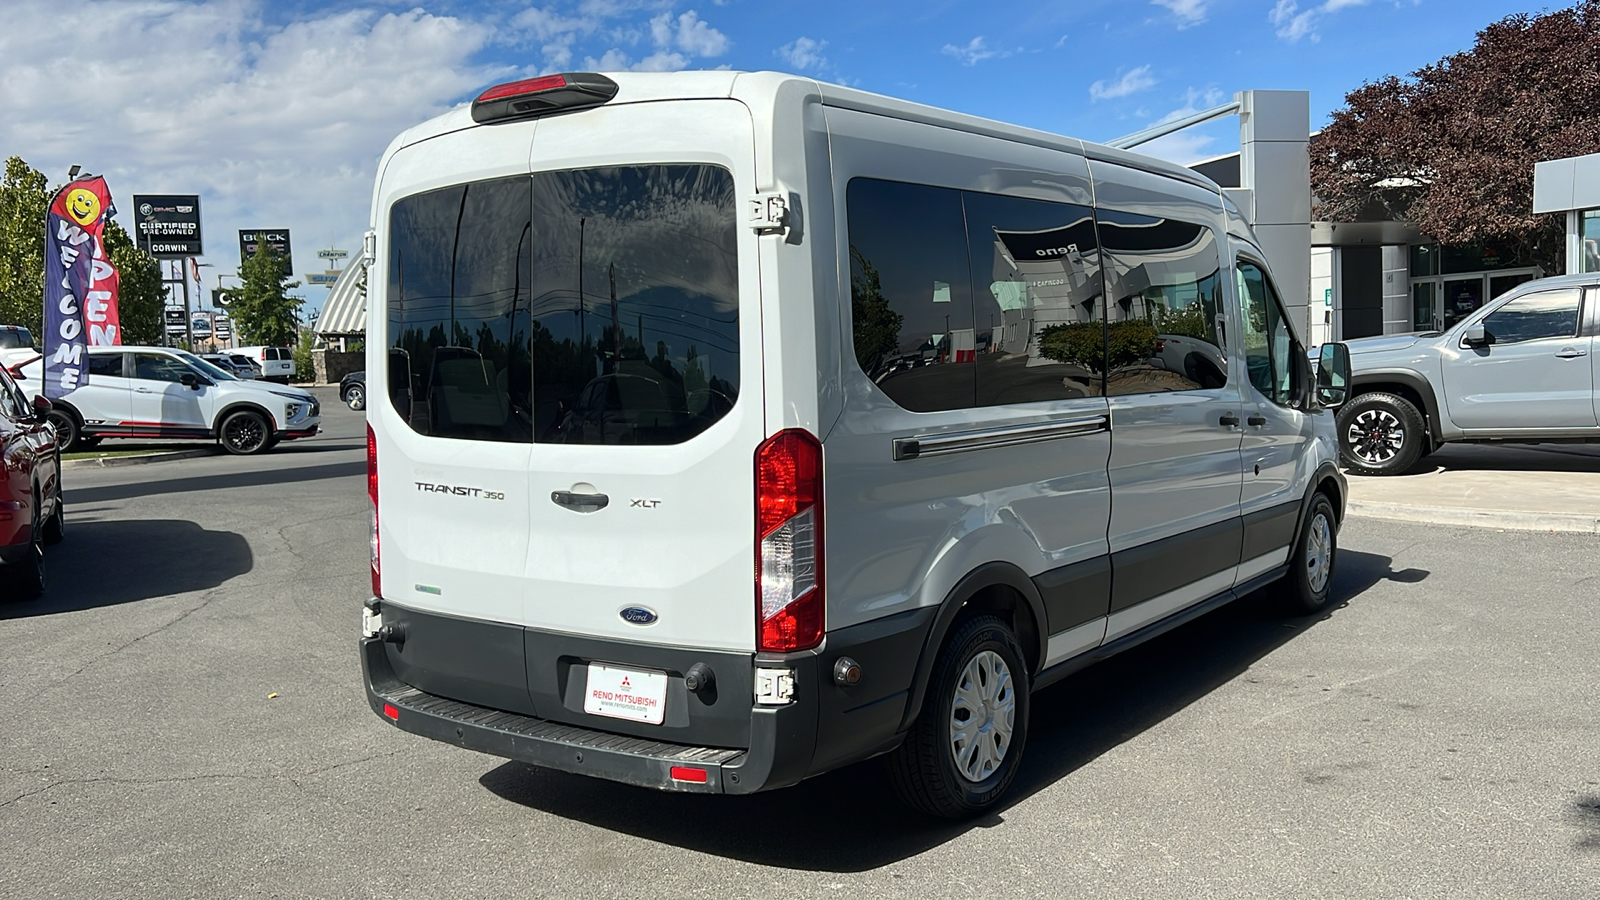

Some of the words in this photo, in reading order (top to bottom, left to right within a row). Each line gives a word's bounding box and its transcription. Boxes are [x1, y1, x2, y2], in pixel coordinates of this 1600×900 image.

[243, 233, 286, 242] BUICK
[152, 244, 188, 252] CORWIN
[246, 243, 285, 252] GC
[414, 481, 483, 499] TRANSIT
[483, 490, 505, 500] 350
[630, 498, 662, 509] XLT
[626, 609, 648, 622] Ford
[592, 689, 613, 701] RENO
[614, 693, 657, 707] MITSUBISHI
[600, 700, 648, 713] www.renomits.com
